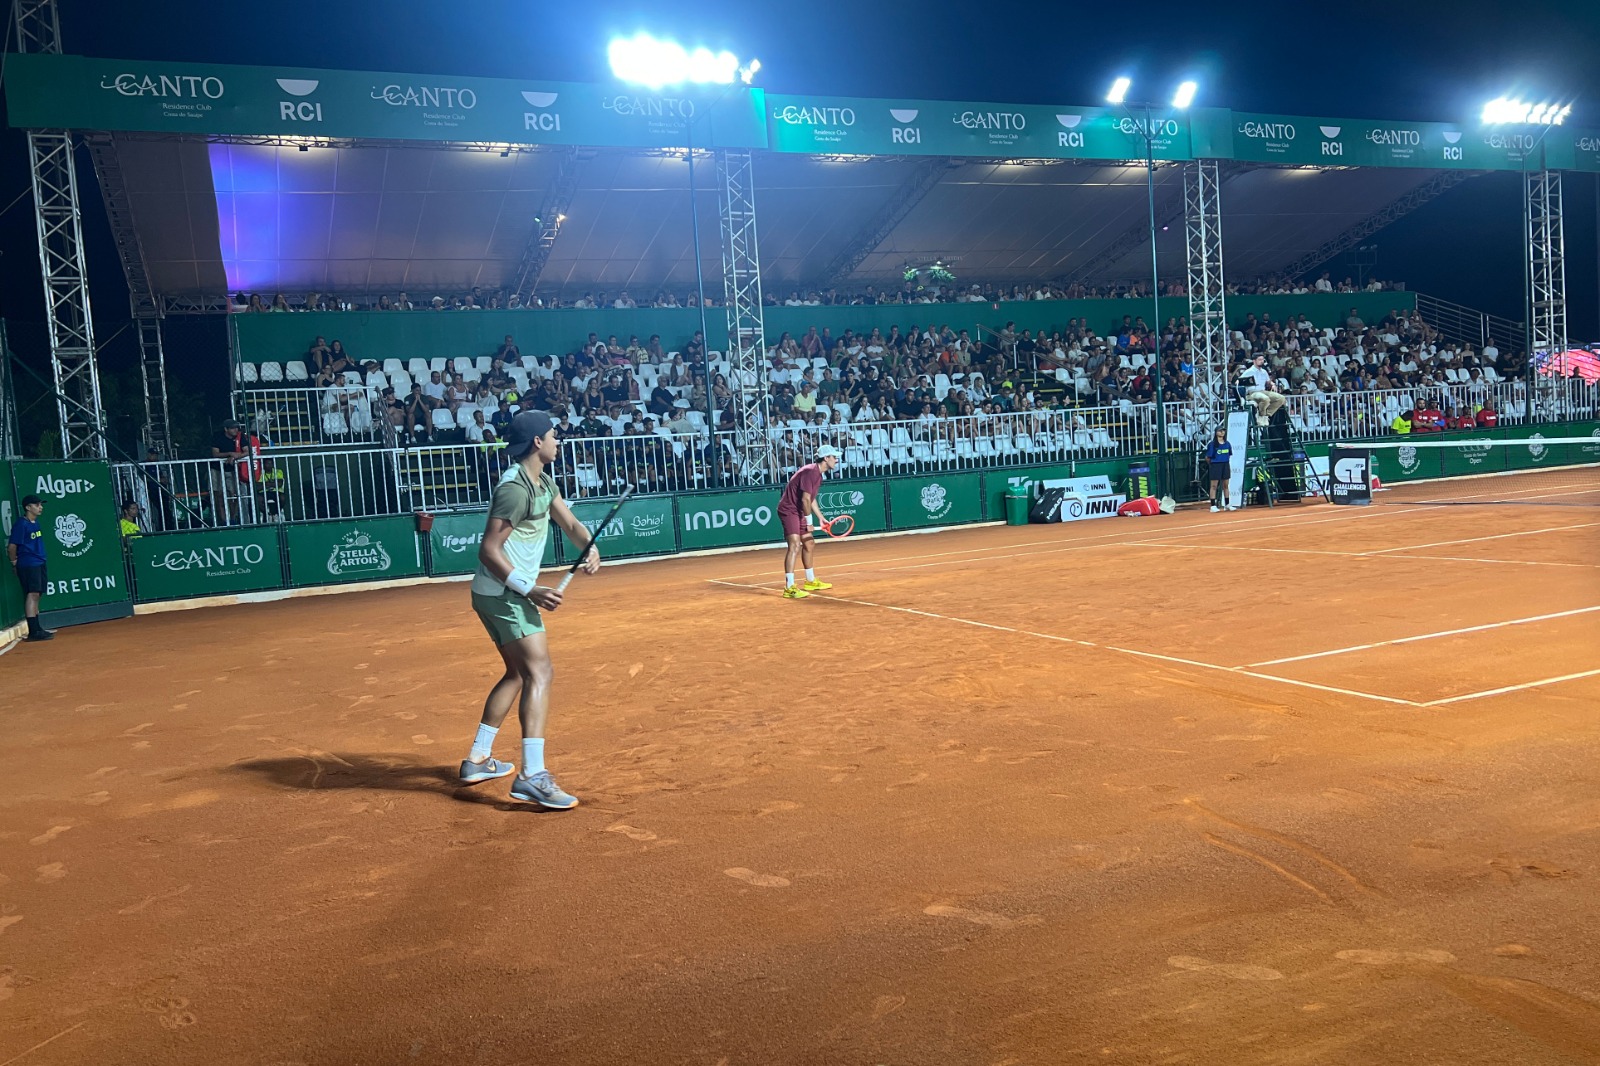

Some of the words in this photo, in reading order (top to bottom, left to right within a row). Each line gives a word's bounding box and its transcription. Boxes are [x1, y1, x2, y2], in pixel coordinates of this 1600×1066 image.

[162, 102, 195, 110] Residence
[196, 103, 212, 111] Club
[280, 101, 322, 122] RCI
[523, 112, 561, 131] RCI
[892, 127, 921, 144] RCI
[1058, 131, 1084, 148] RCI
[1321, 141, 1343, 156] RCI
[1443, 146, 1462, 160] RCI
[36, 473, 82, 499] Algar
[1090, 483, 1106, 491] INNI
[1333, 483, 1366, 491] CHALLENGER
[1085, 499, 1118, 515] INNI
[684, 505, 772, 531] INDIGO
[61, 521, 75, 530] Hot
[62, 530, 79, 538] Park
[634, 529, 660, 537] TURISMO
[339, 548, 377, 559] STELLA
[340, 556, 379, 567] ARTOIS
[46, 575, 116, 595] BRETON
